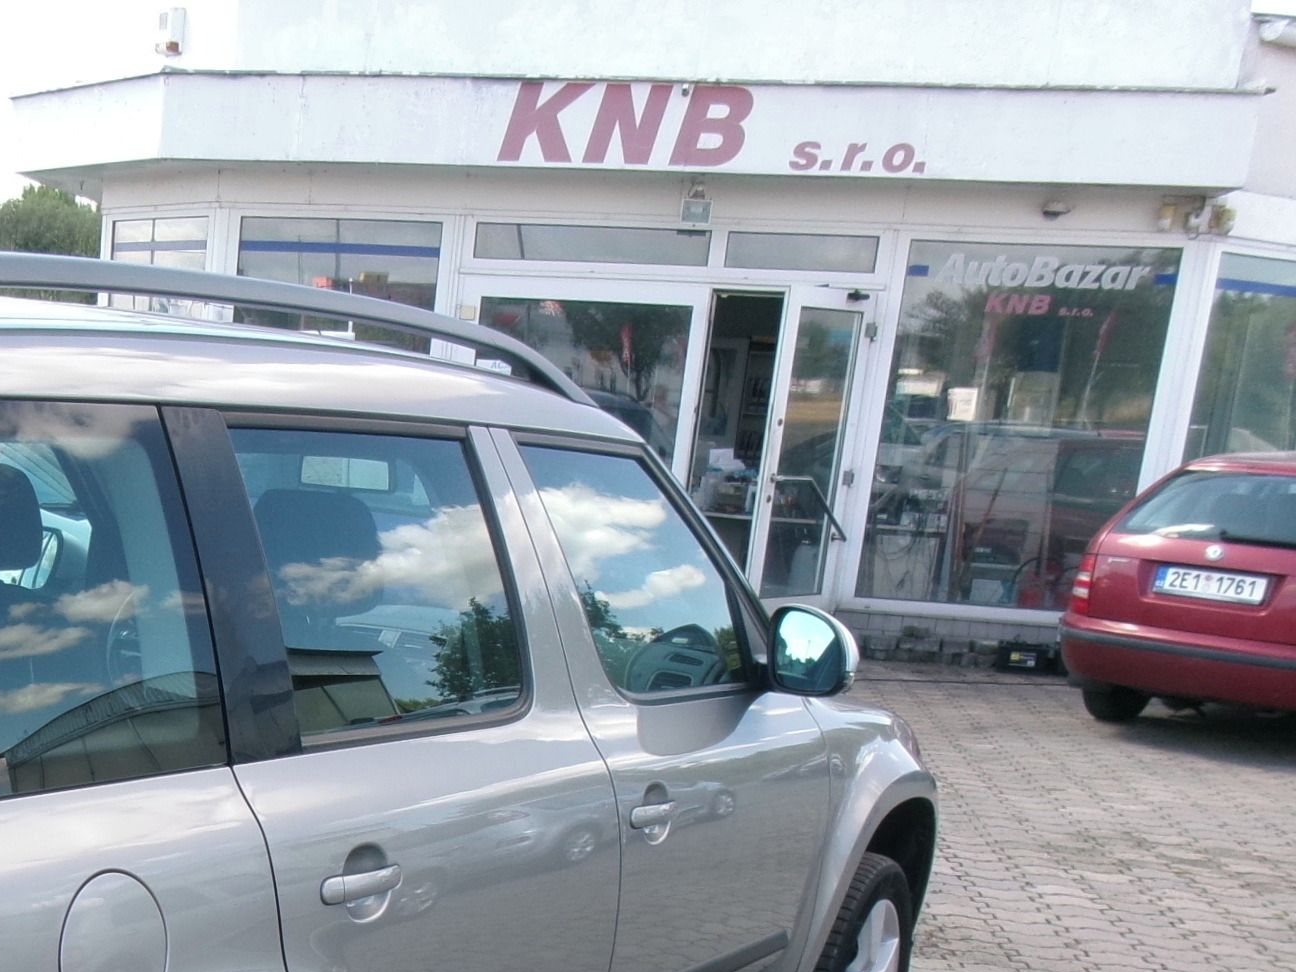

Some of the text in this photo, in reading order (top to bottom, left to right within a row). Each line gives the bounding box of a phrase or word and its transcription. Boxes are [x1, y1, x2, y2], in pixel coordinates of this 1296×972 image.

[496, 81, 926, 174] KNB s.r.o.
[934, 253, 1151, 290] AutoBazar
[984, 291, 1052, 315] KNB
[1168, 571, 1202, 590] 2E1
[1215, 576, 1257, 597] 1761
